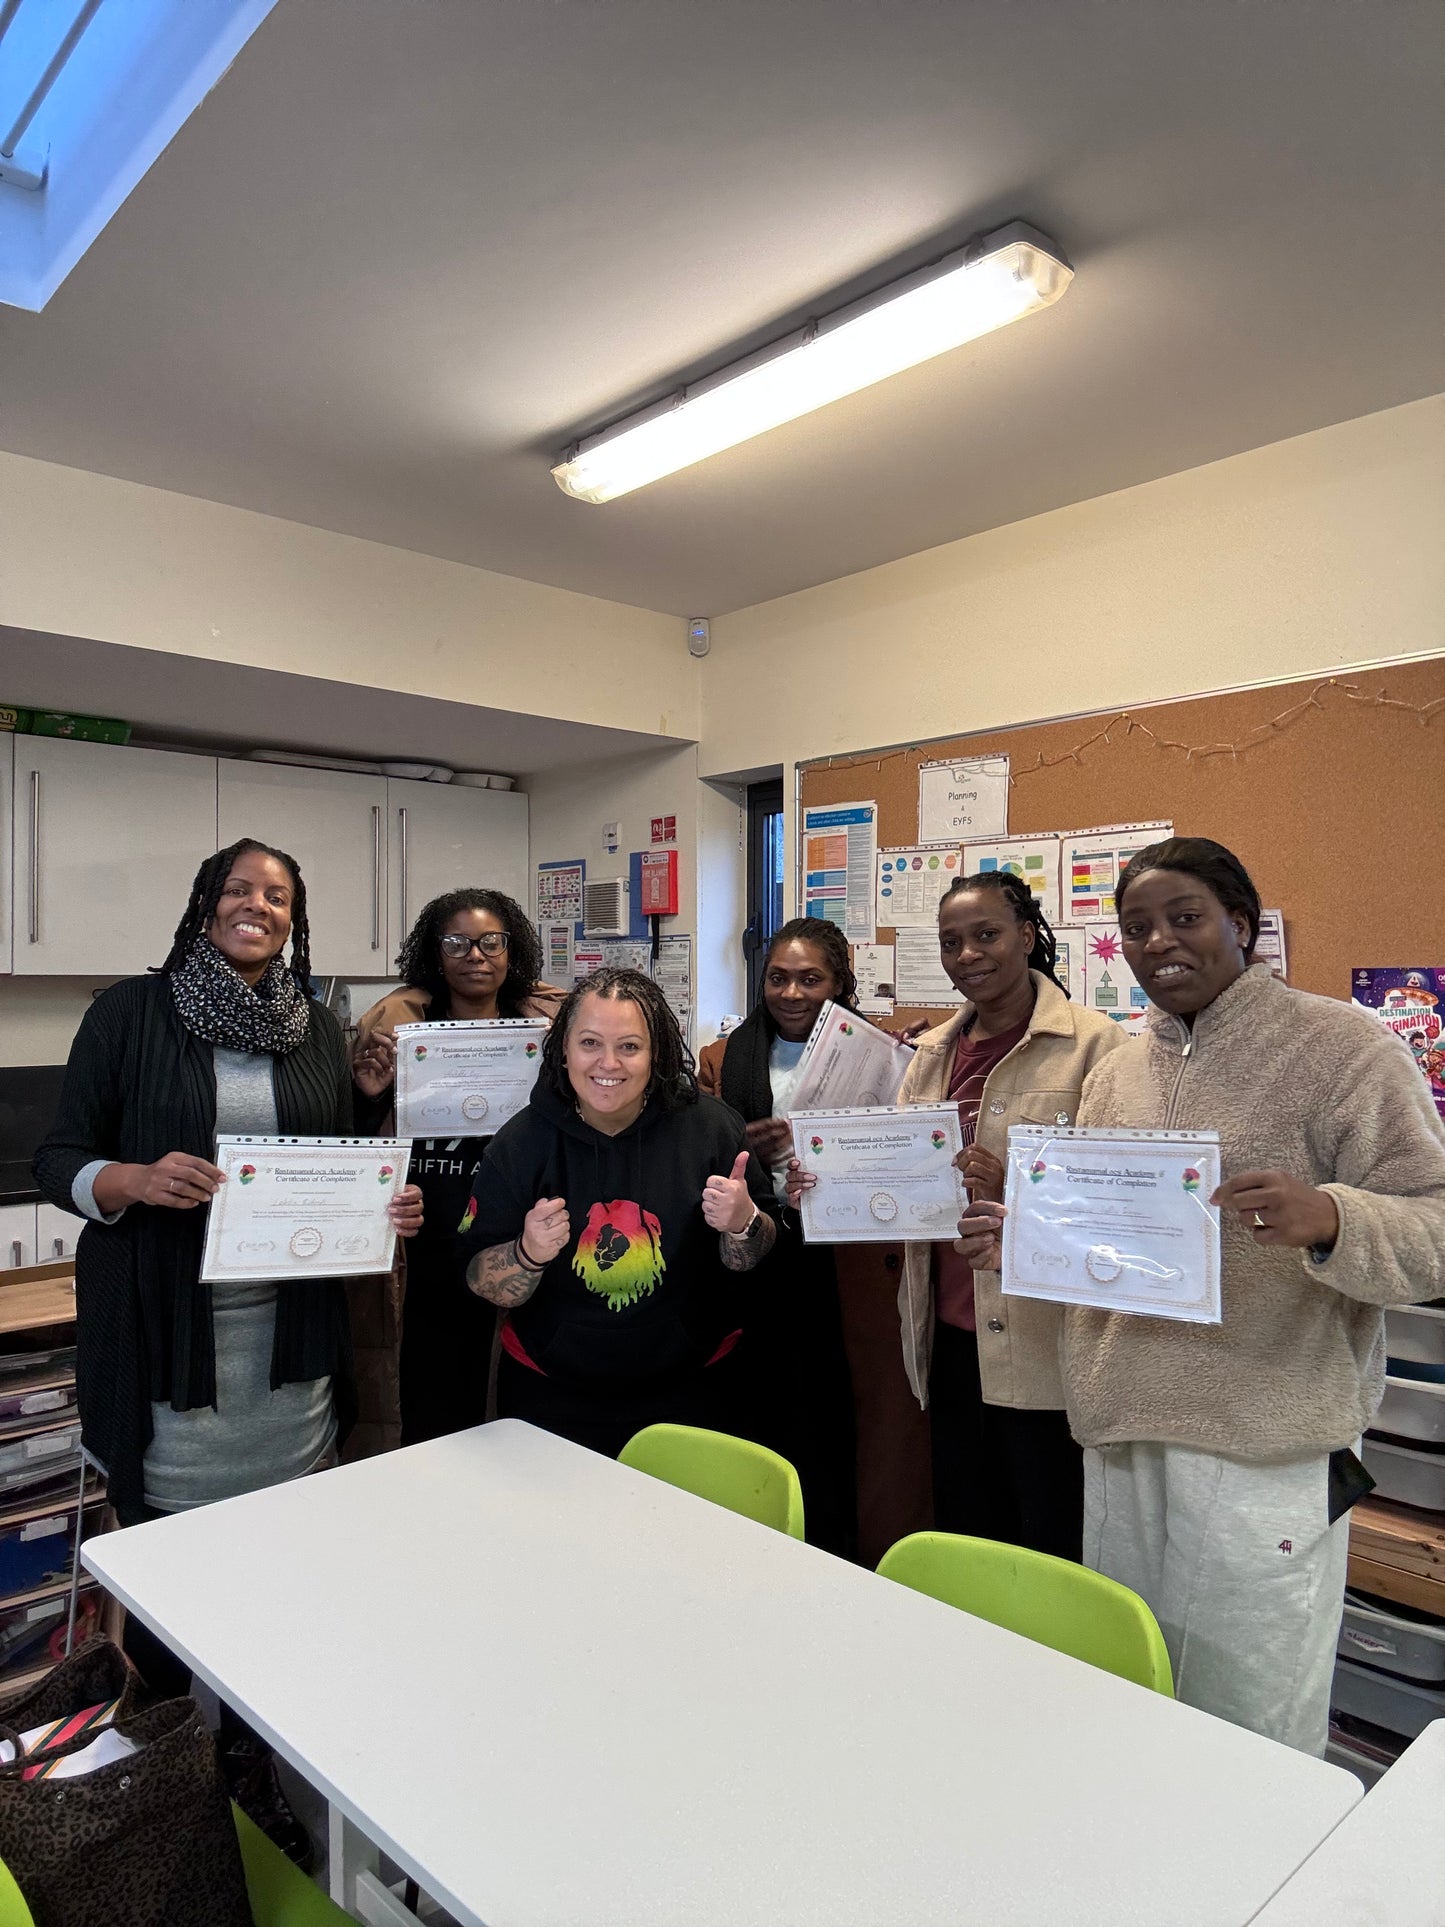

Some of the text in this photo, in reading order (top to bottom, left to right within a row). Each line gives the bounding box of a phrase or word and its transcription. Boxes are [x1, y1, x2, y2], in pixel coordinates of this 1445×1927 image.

[948, 790, 978, 801] Planning
[952, 816, 972, 826] EYFS
[1379, 1007, 1431, 1017] DESTINATION
[408, 1159, 463, 1175] FIFTH
[320, 1175, 357, 1184] Completion
